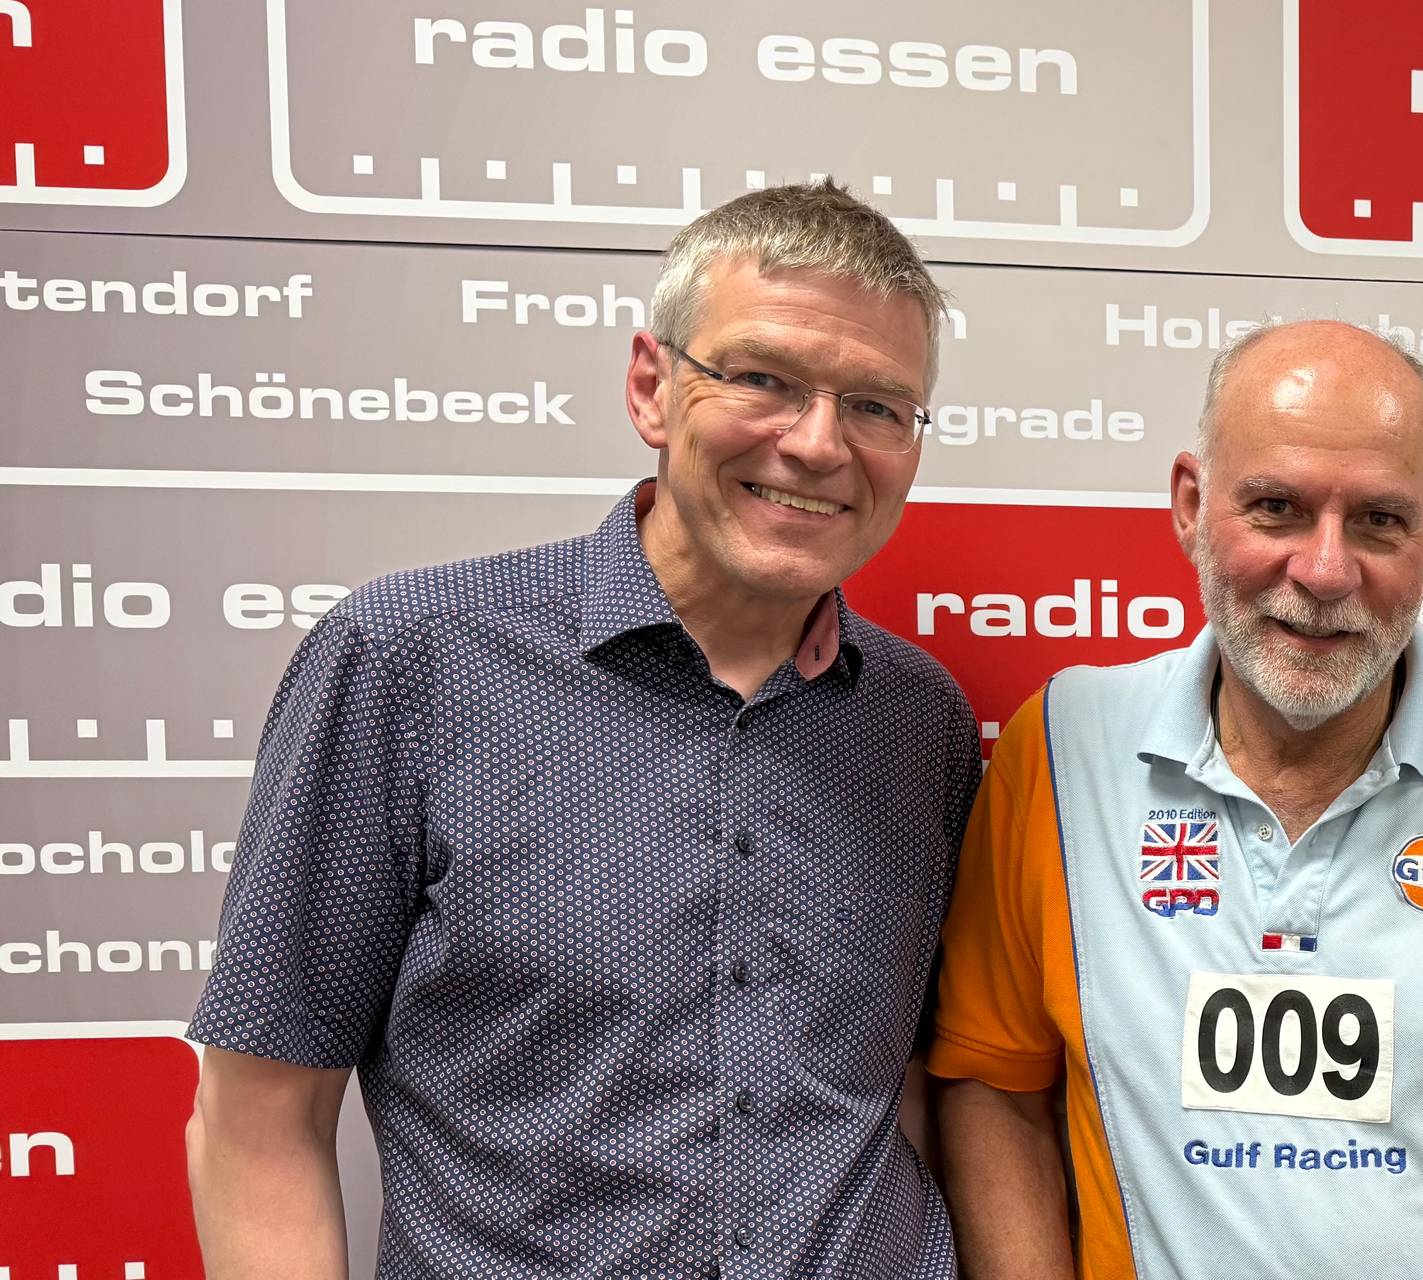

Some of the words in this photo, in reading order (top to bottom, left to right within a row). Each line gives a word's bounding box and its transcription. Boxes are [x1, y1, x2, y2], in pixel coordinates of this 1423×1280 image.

[414, 9, 708, 77] radio
[757, 34, 1078, 95] essen
[84, 370, 575, 425] Schönebeck
[924, 400, 1145, 446] grade
[917, 579, 1185, 639] radio
[1148, 808, 1178, 820] 2010
[1179, 807, 1217, 820] Edition
[1198, 987, 1380, 1101] 009
[1183, 1138, 1262, 1169] Gulf
[1273, 1138, 1408, 1175] Racing
